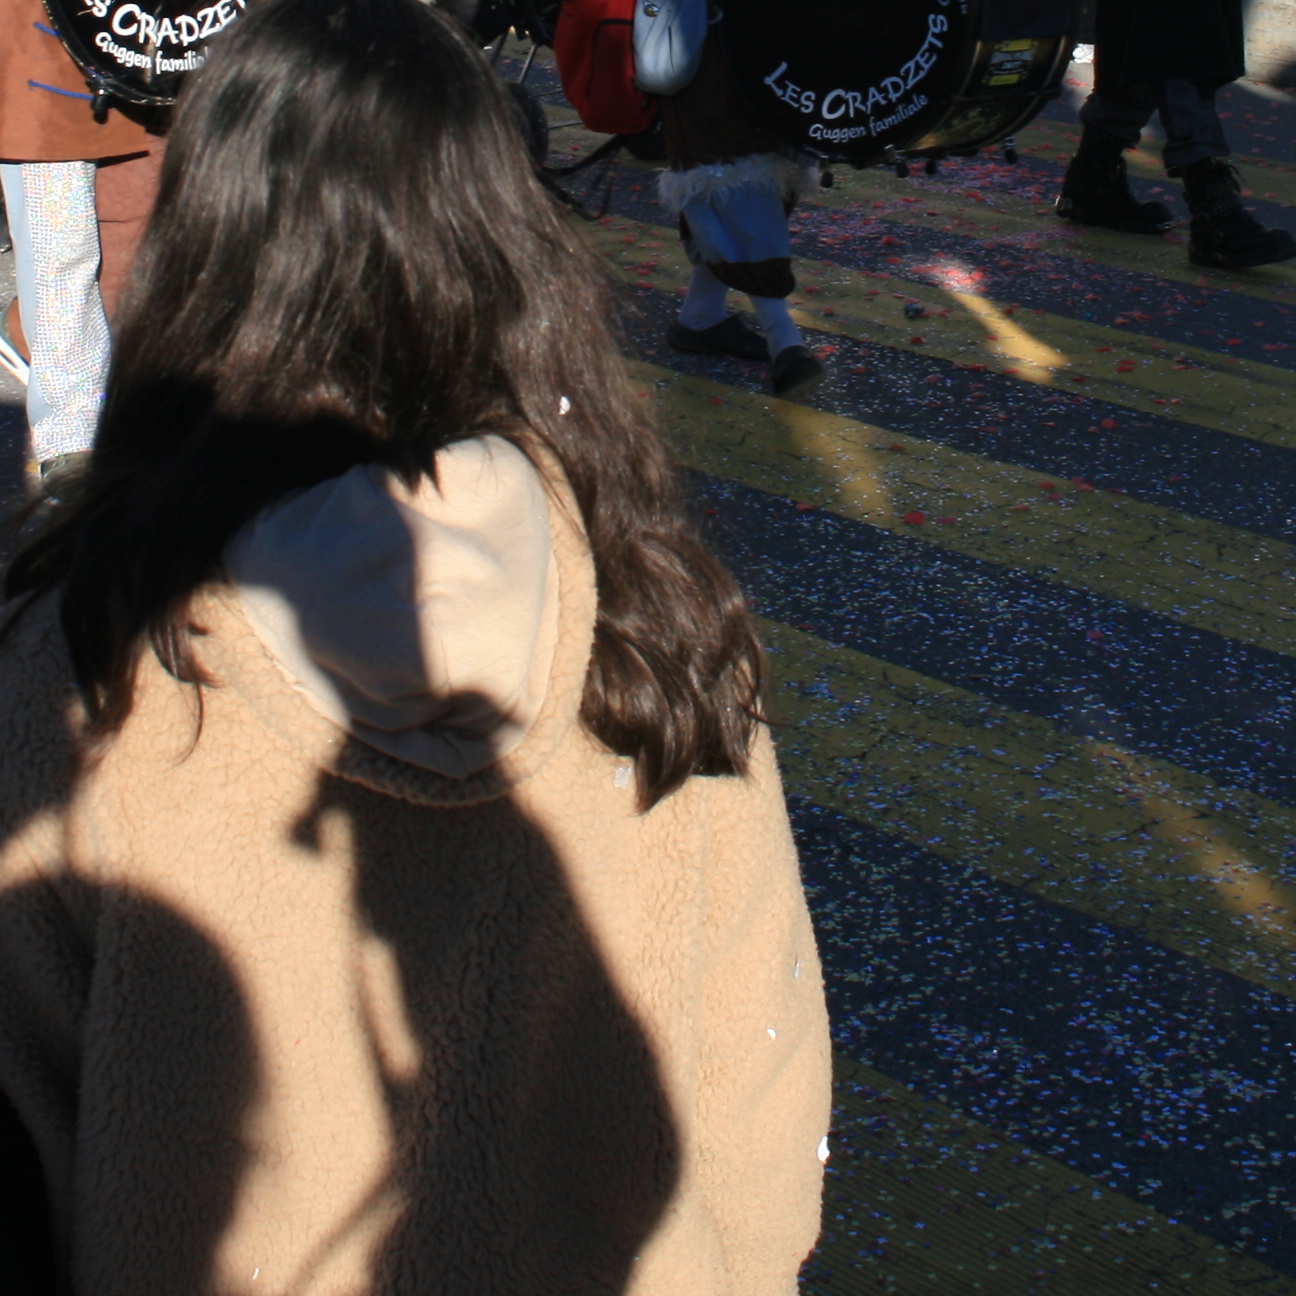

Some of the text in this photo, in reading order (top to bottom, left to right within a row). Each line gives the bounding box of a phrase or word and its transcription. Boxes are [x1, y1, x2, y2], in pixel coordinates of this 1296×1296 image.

[94, 31, 208, 75] Guggen familia
[764, 61, 817, 113] LES
[821, 13, 949, 120] CRADZETS
[808, 93, 929, 143] Guggen familiale
